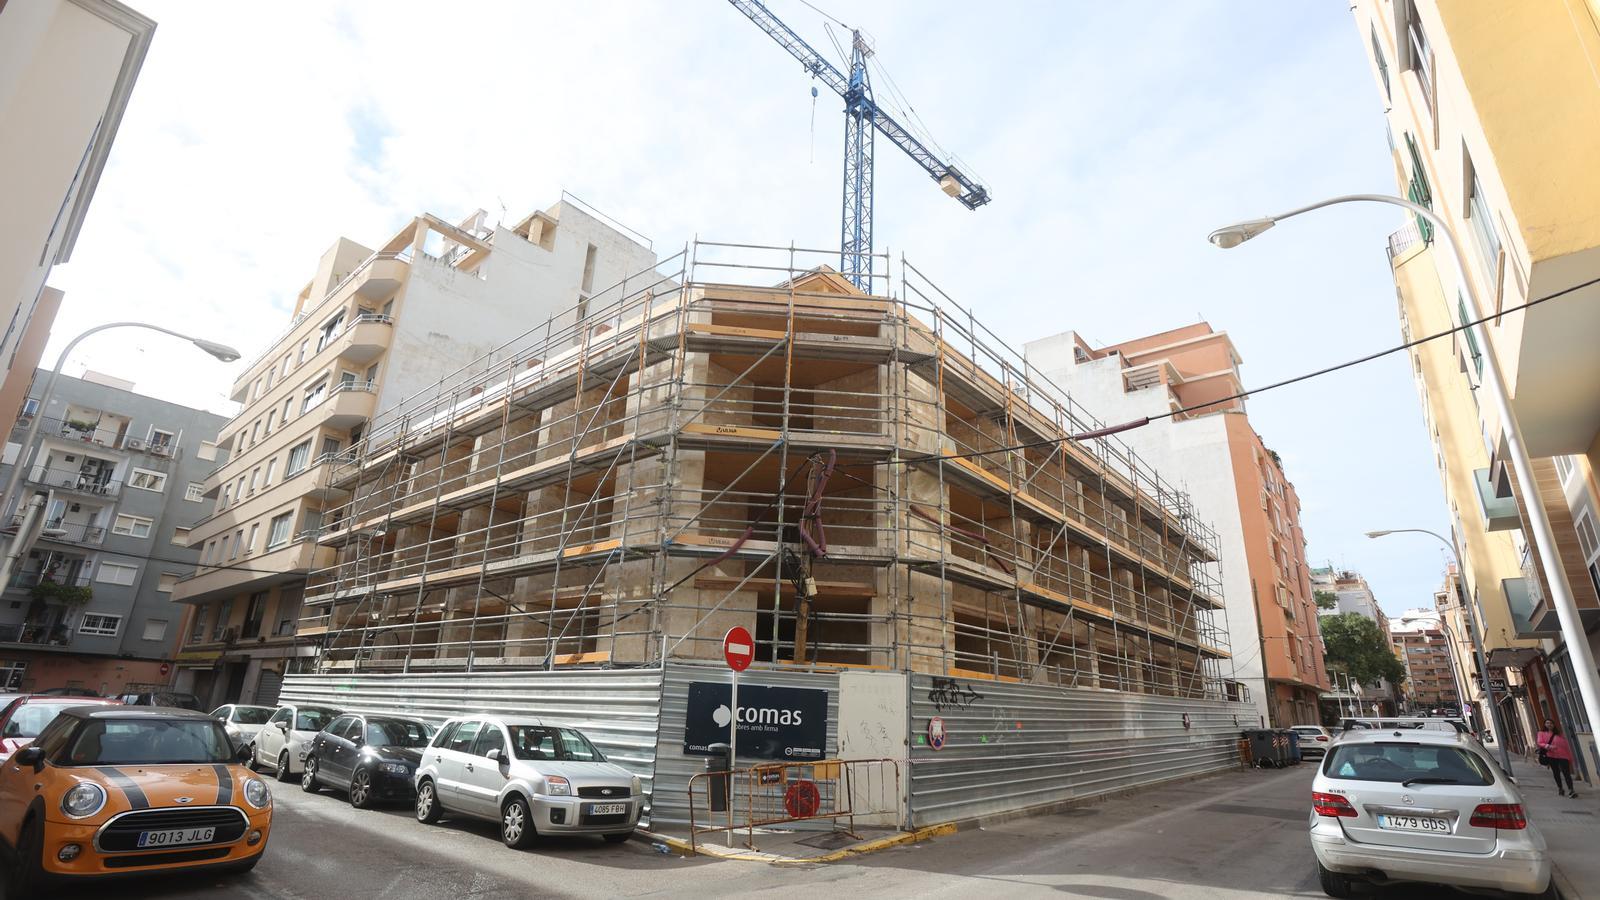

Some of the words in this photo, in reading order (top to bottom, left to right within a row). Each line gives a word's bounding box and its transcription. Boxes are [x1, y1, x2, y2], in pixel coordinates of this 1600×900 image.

[736, 706, 802, 725] comas
[594, 805, 610, 813] 4085
[1387, 816, 1418, 828] 1479
[1421, 818, 1446, 831] GDS
[148, 831, 184, 845] 9013
[187, 829, 212, 841] JLG
